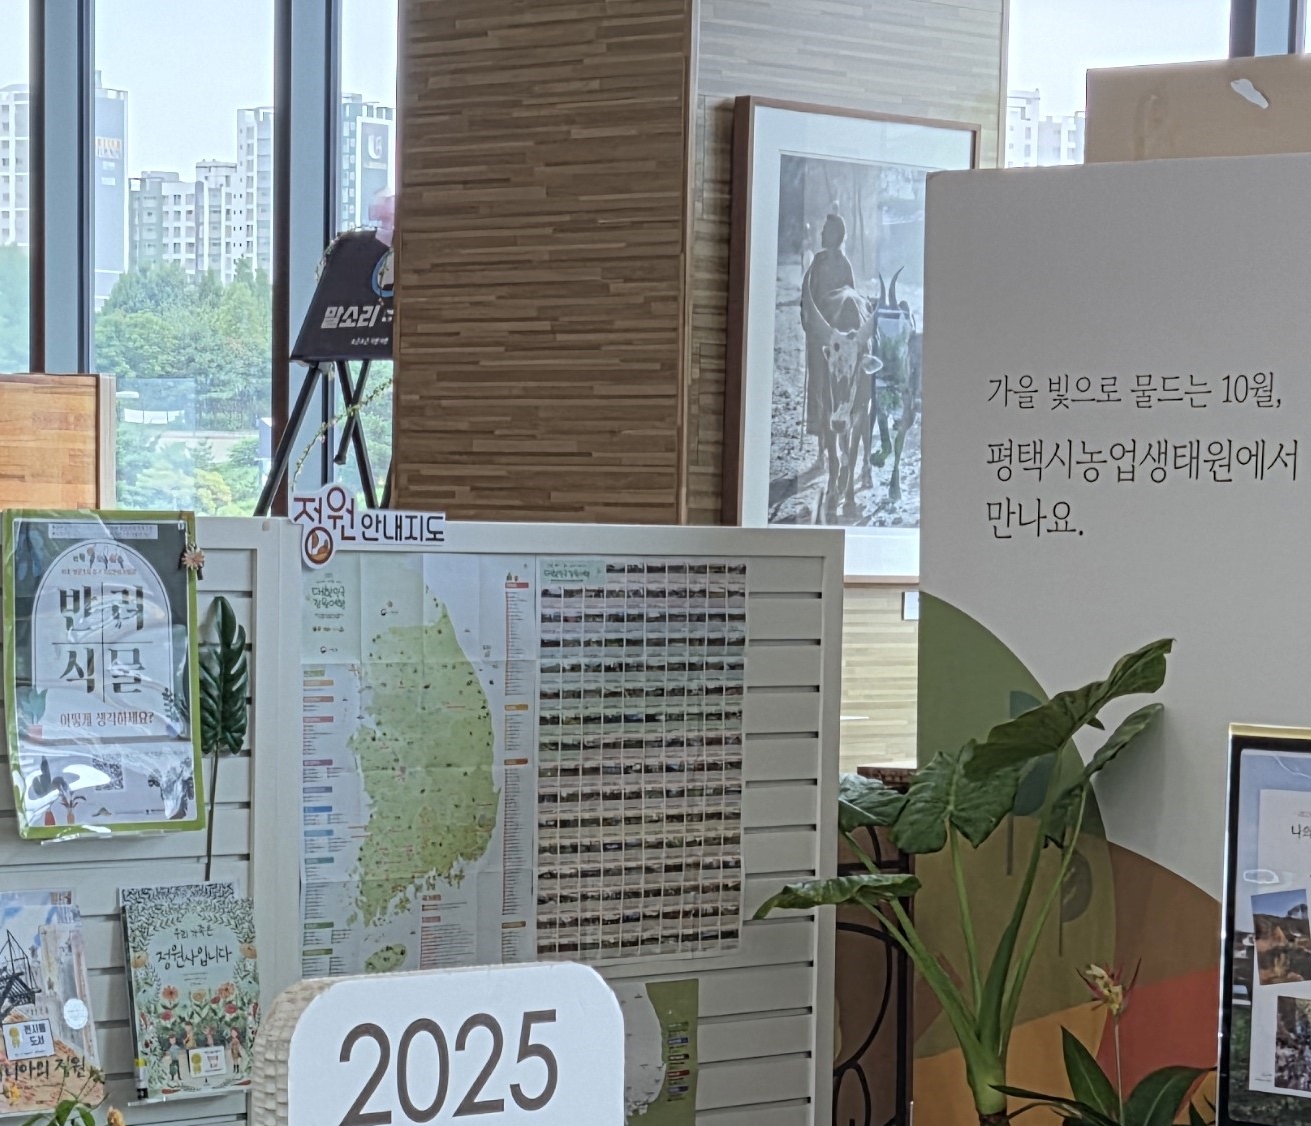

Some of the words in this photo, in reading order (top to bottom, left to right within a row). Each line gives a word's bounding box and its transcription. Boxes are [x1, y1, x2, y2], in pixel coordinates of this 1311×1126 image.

[988, 374, 1039, 410] 가을
[1048, 374, 1122, 411] 빛으로
[1130, 374, 1212, 410] 물드는
[1221, 371, 1282, 410] 10월,
[986, 438, 1298, 484] 평택시농업생태원에서
[294, 487, 356, 565] 정원
[361, 513, 445, 542] 안내지도
[986, 497, 1084, 539] 만나요.
[60, 712, 93, 727] 어떻게
[97, 711, 155, 727] 생각하세요?
[156, 944, 233, 970] 정원사입니다
